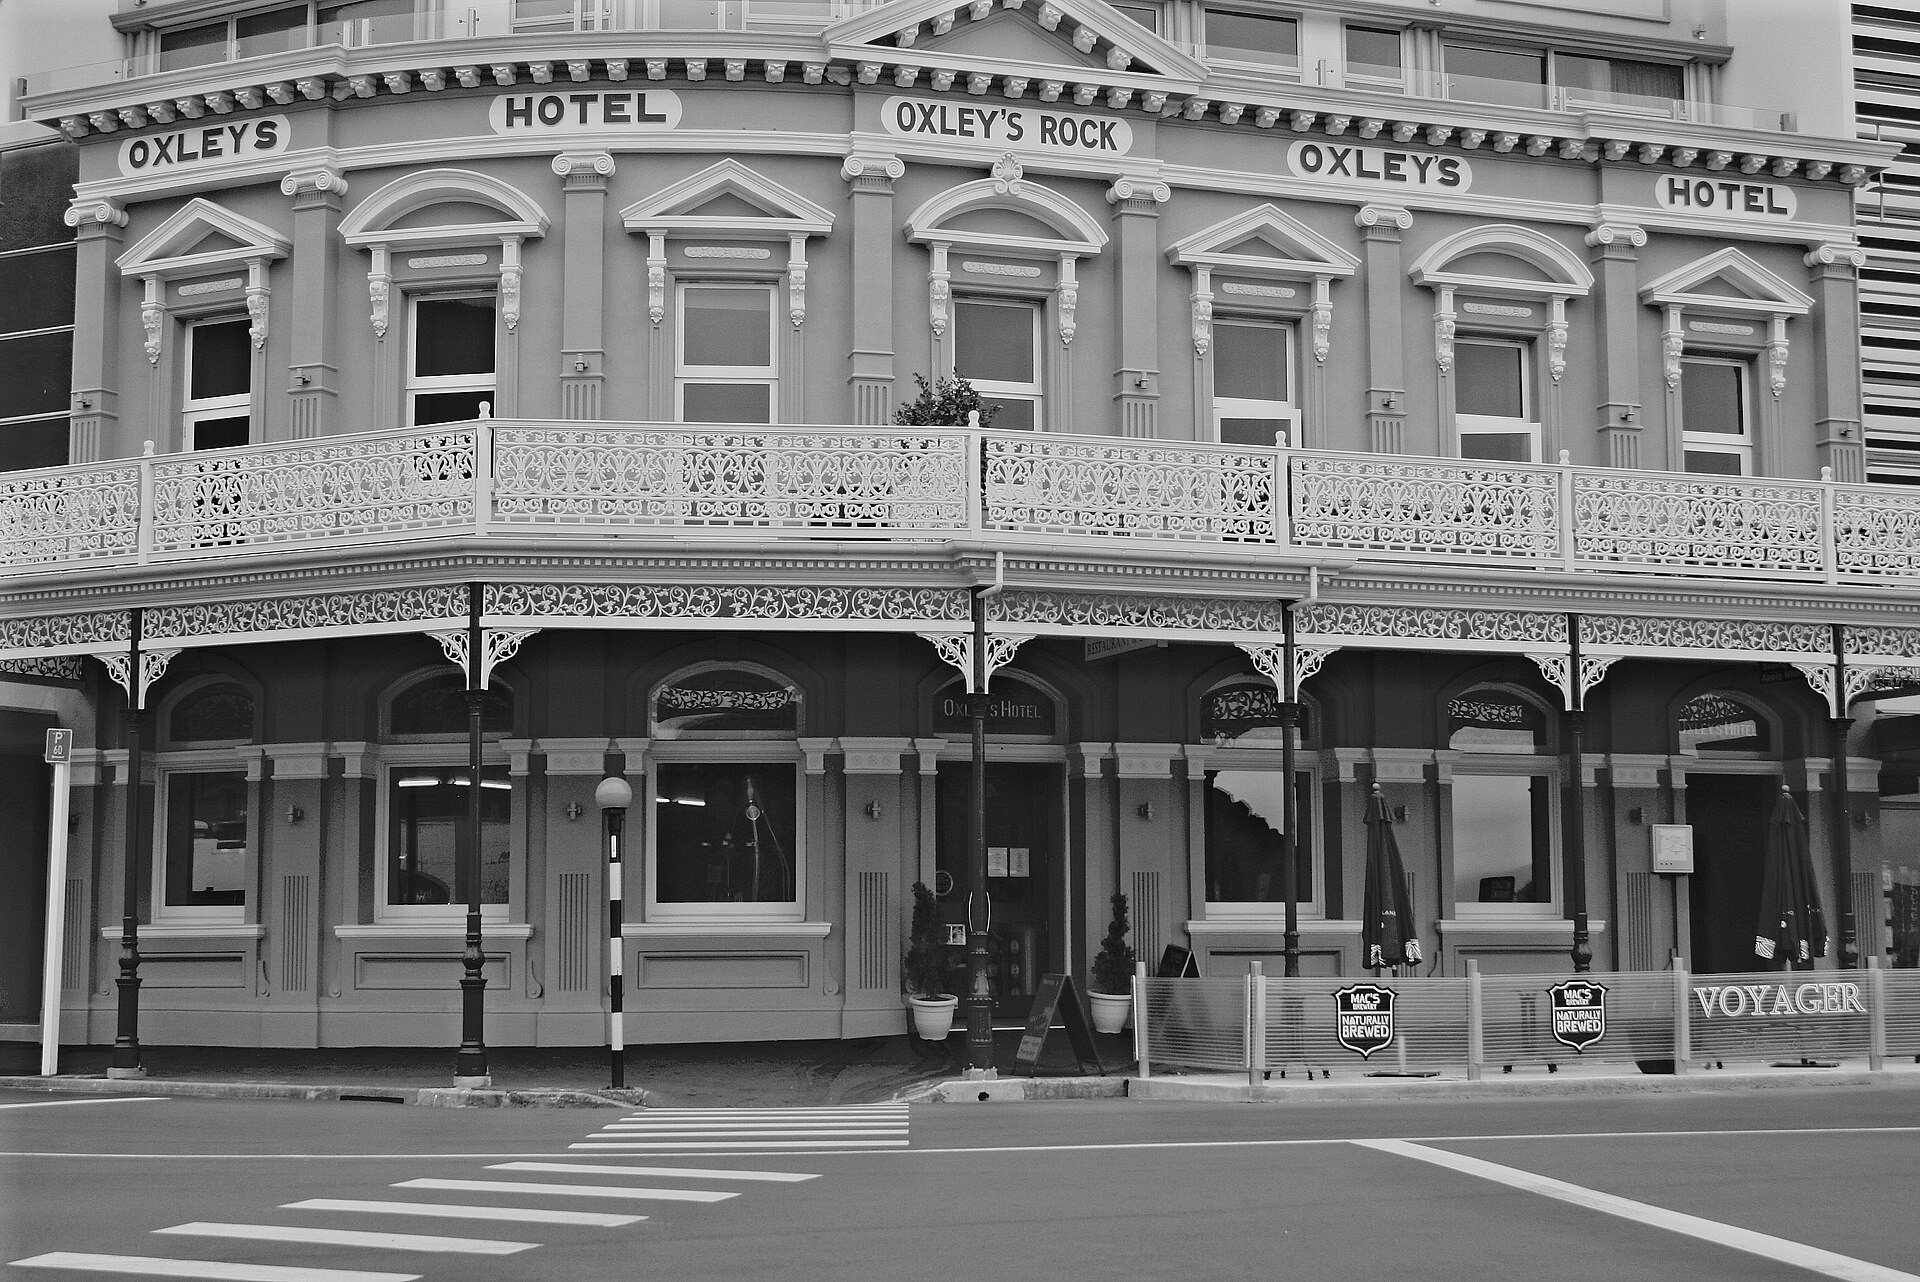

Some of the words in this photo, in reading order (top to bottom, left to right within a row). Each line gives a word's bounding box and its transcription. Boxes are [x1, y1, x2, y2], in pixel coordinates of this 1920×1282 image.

[505, 92, 667, 127] HOTEL
[896, 101, 1024, 142] OXLEY'S
[1039, 115, 1118, 151] ROCK
[128, 120, 278, 169] OXLEYS
[1300, 144, 1461, 187] OXLEY'S
[1668, 177, 1788, 215] HOTEL
[944, 699, 998, 717] OXLS
[55, 732, 63, 744] P
[54, 745, 63, 755] 60
[1350, 992, 1381, 1004] MAC'S
[1563, 988, 1593, 1000] MAC'S
[1693, 982, 1867, 1019] VOYAGER
[1341, 1015, 1390, 1026] NATURALLY
[1556, 1010, 1601, 1021] NATURALLY
[1342, 1025, 1390, 1038] BREWED
[1556, 1019, 1602, 1033] BREWED
